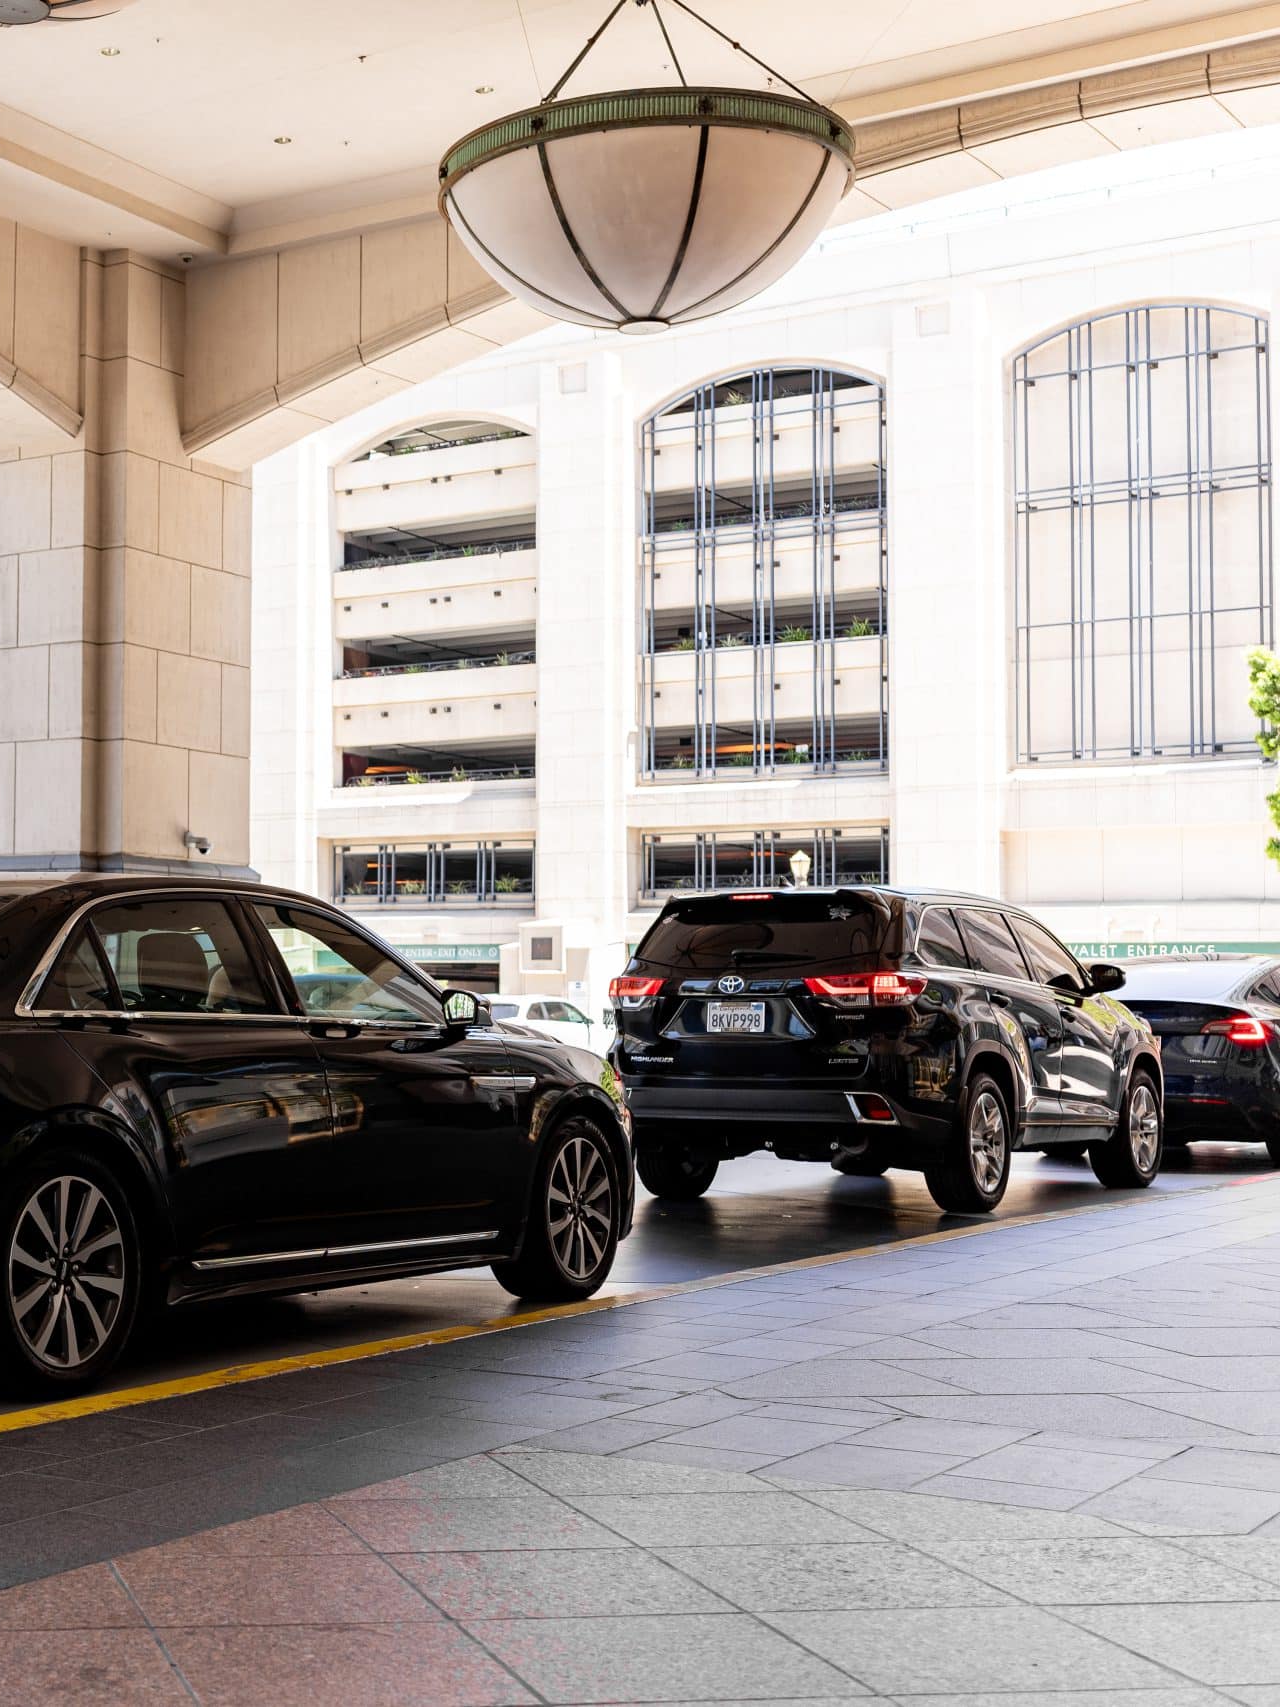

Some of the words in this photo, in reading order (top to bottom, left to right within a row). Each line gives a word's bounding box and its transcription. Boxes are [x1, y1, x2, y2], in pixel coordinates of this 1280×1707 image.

[458, 948, 481, 957] ONLY
[1068, 944, 1118, 957] VALET
[1127, 944, 1216, 957] ENTRANCE
[711, 1013, 761, 1028] 8KVP998
[631, 1055, 674, 1063] HIGHLANDER
